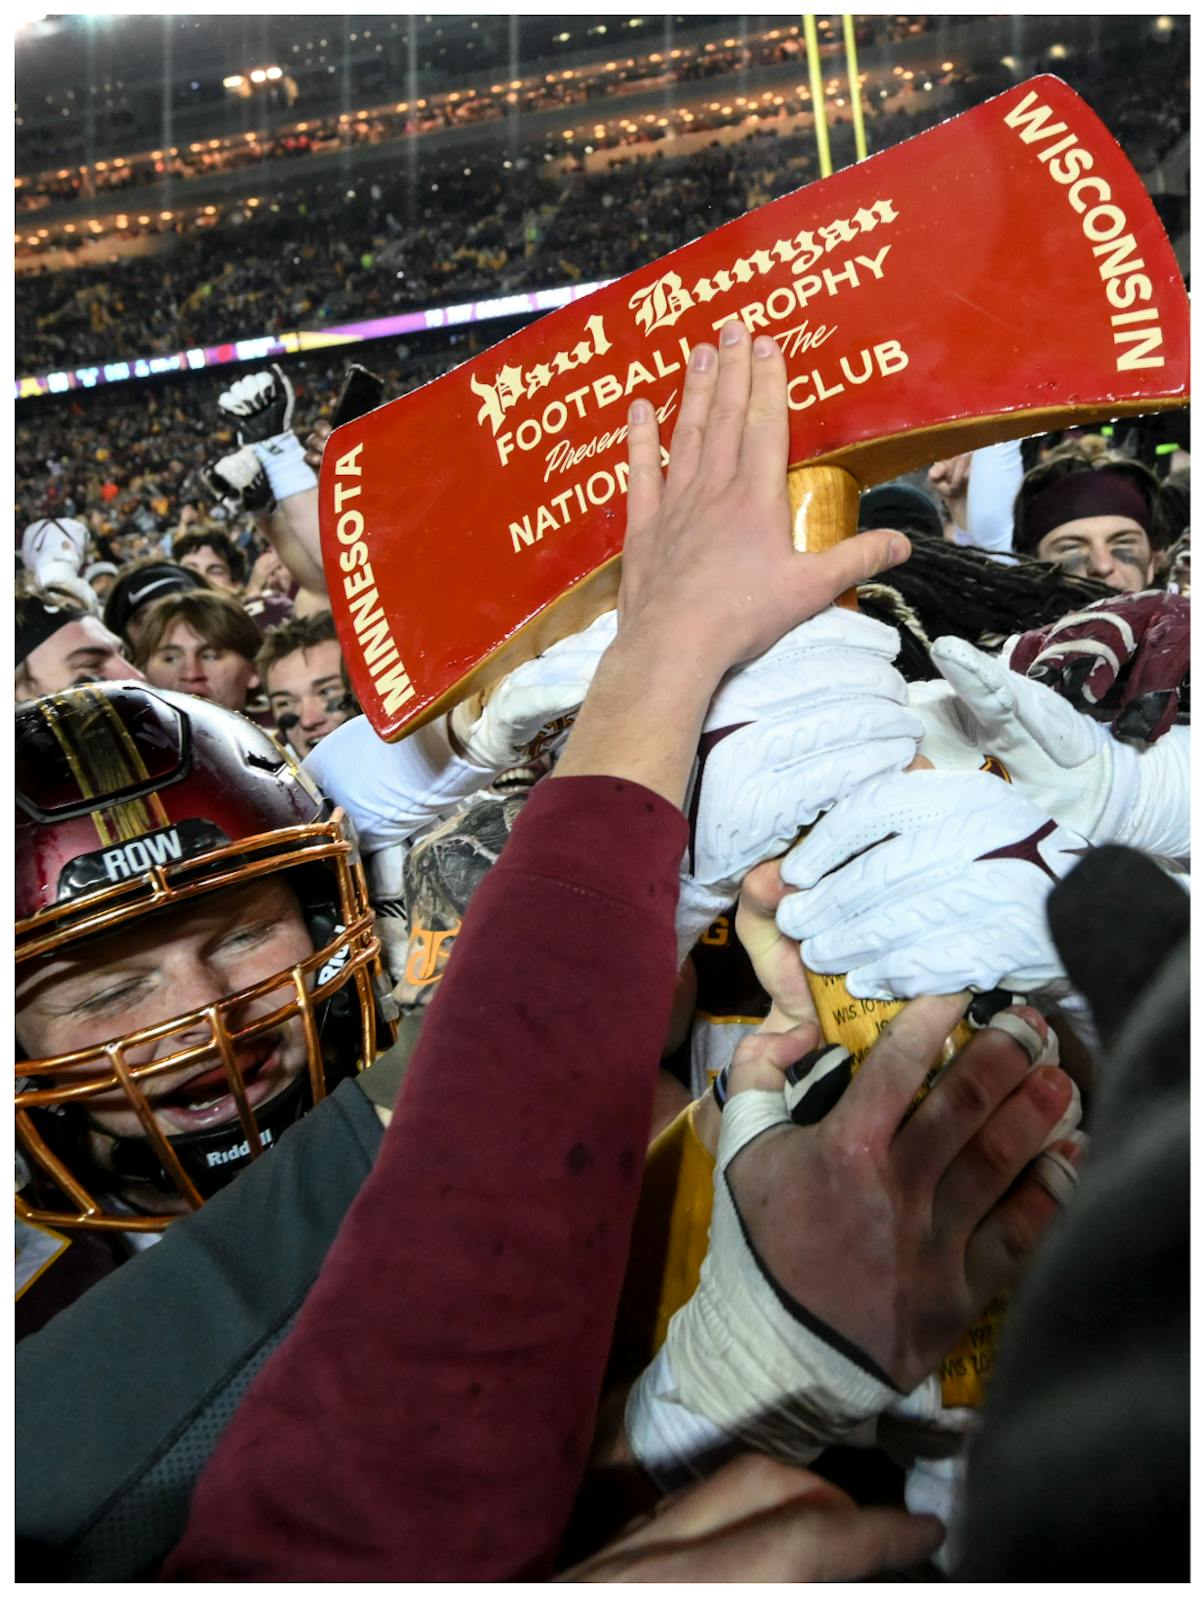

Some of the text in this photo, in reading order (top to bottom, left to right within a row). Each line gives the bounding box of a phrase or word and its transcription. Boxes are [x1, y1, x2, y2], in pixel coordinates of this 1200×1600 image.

[470, 314, 613, 437] Paul
[628, 198, 899, 337] Bunyan
[1003, 90, 1165, 372] WISCONSIN
[507, 340, 909, 553] NATION CLUB
[543, 319, 838, 483] Presend The
[334, 442, 416, 717] MINNESOTA
[102, 829, 183, 882] ROW
[206, 1127, 273, 1169] Riddll
